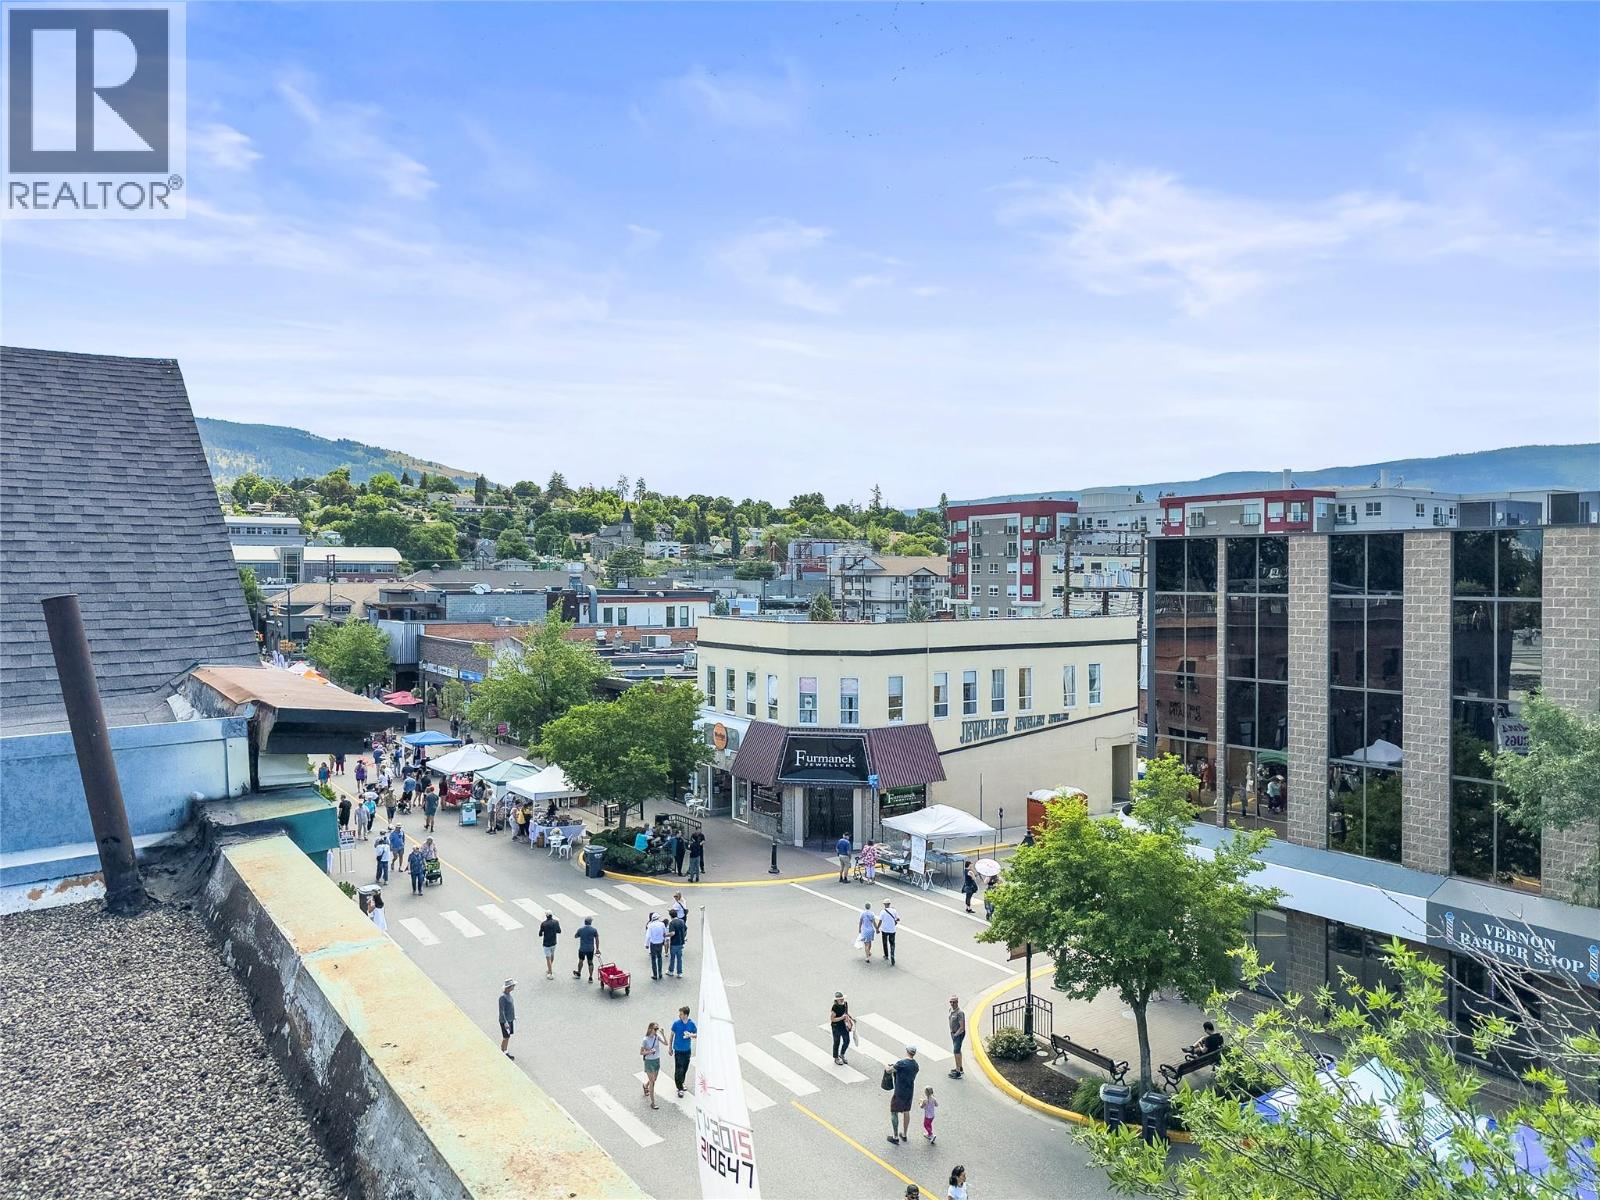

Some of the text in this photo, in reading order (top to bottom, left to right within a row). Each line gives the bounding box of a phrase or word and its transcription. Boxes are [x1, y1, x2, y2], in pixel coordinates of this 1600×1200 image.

[960, 718, 1009, 744] JEWELLERY
[794, 749, 856, 767] Furmanek
[1483, 923, 1557, 952] VERNON
[1460, 932, 1585, 973] BARBER SHOP
